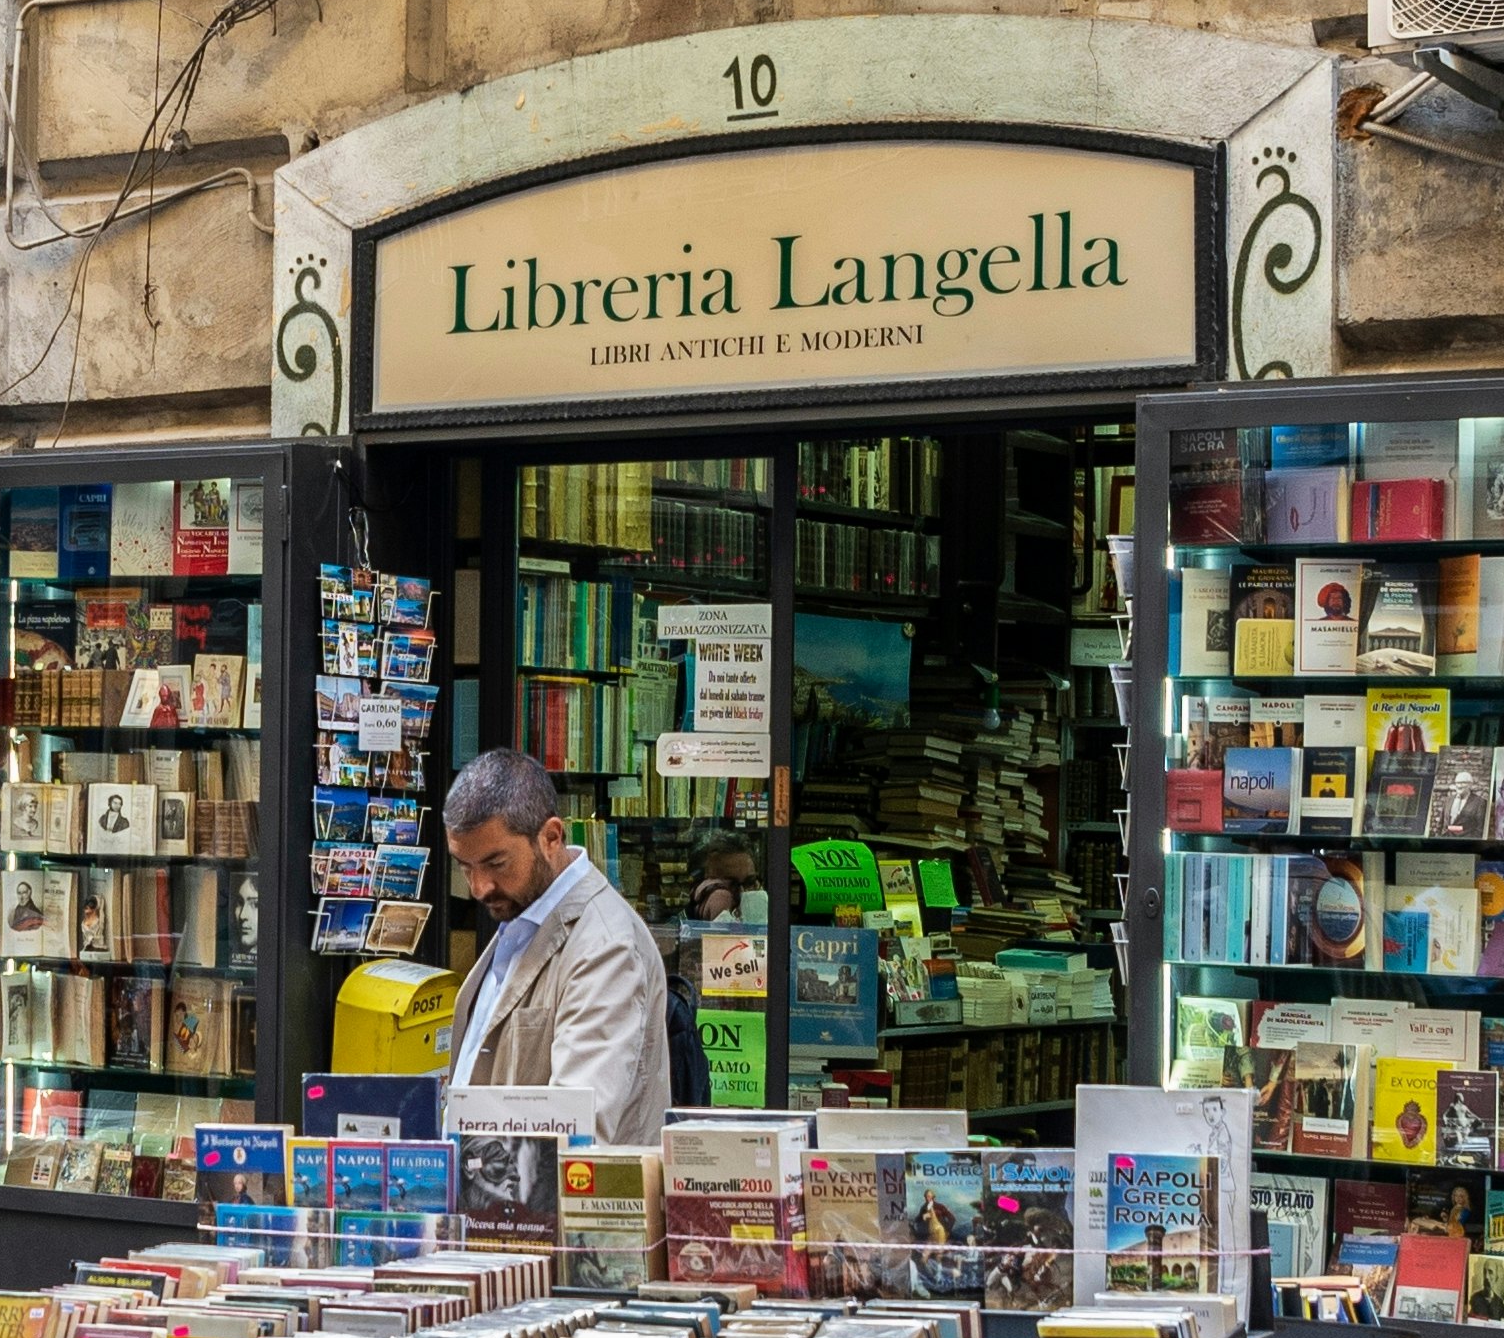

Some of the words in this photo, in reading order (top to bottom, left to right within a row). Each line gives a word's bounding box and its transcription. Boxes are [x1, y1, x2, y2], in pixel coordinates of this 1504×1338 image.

[723, 52, 779, 111] 10
[446, 242, 741, 336] Libreria
[769, 209, 1130, 318] Langella
[589, 342, 652, 367] LIBRI
[658, 335, 767, 362] ANTICHI
[775, 333, 792, 355] E
[799, 324, 925, 352] MODERNI
[1180, 430, 1225, 441] NAPOLI
[1180, 442, 1225, 452] SACRA
[78, 493, 107, 503] CAPRI
[698, 610, 728, 621] ZONA
[663, 623, 768, 636] DEAMAZZONIZZATA
[698, 643, 731, 662] WHITE
[733, 643, 764, 662] WEEK
[708, 671, 716, 683] Da
[717, 672, 725, 683] noi
[726, 672, 738, 683] tante
[731, 689, 748, 702] sabato
[361, 703, 401, 714] CARTOLINE
[1261, 701, 1295, 709] NAPOLI
[1380, 702, 1394, 712] Re
[1395, 702, 1406, 712] di
[1408, 702, 1441, 713] Napoli
[724, 707, 733, 719] del
[734, 707, 748, 719] black
[748, 707, 764, 722] friday
[376, 719, 398, 729] 0,60
[1230, 771, 1275, 795] napoli
[332, 849, 374, 859] NAPOLI
[807, 848, 860, 868] NON
[814, 876, 870, 889] VENDIAMO
[812, 893, 834, 902] LIBRI
[835, 892, 878, 903] SCOLASTICI
[796, 931, 860, 960] Capri
[709, 966, 732, 981] We
[734, 960, 759, 976] Sell
[412, 994, 443, 1016] POST
[697, 1022, 742, 1049] ON
[1391, 1076, 1404, 1087] EX
[457, 1117, 498, 1133] terra
[503, 1116, 529, 1133] dei
[531, 1117, 577, 1134] valori
[391, 1157, 446, 1169] НЕАПОЛЬ
[809, 1173, 820, 1184] IL
[1115, 1166, 1212, 1189] NAPOLI
[811, 1186, 828, 1198] DI
[1123, 1188, 1202, 1206] GRECO
[591, 1198, 643, 1212] MASTRIANI
[709, 1201, 753, 1210] VOCABOLARIO
[753, 1202, 774, 1211] DELLA
[1274, 1191, 1314, 1210] VELATO
[722, 1209, 746, 1218] LINGUA
[746, 1210, 774, 1218] ITALIANA
[1115, 1207, 1212, 1227] ROMANA
